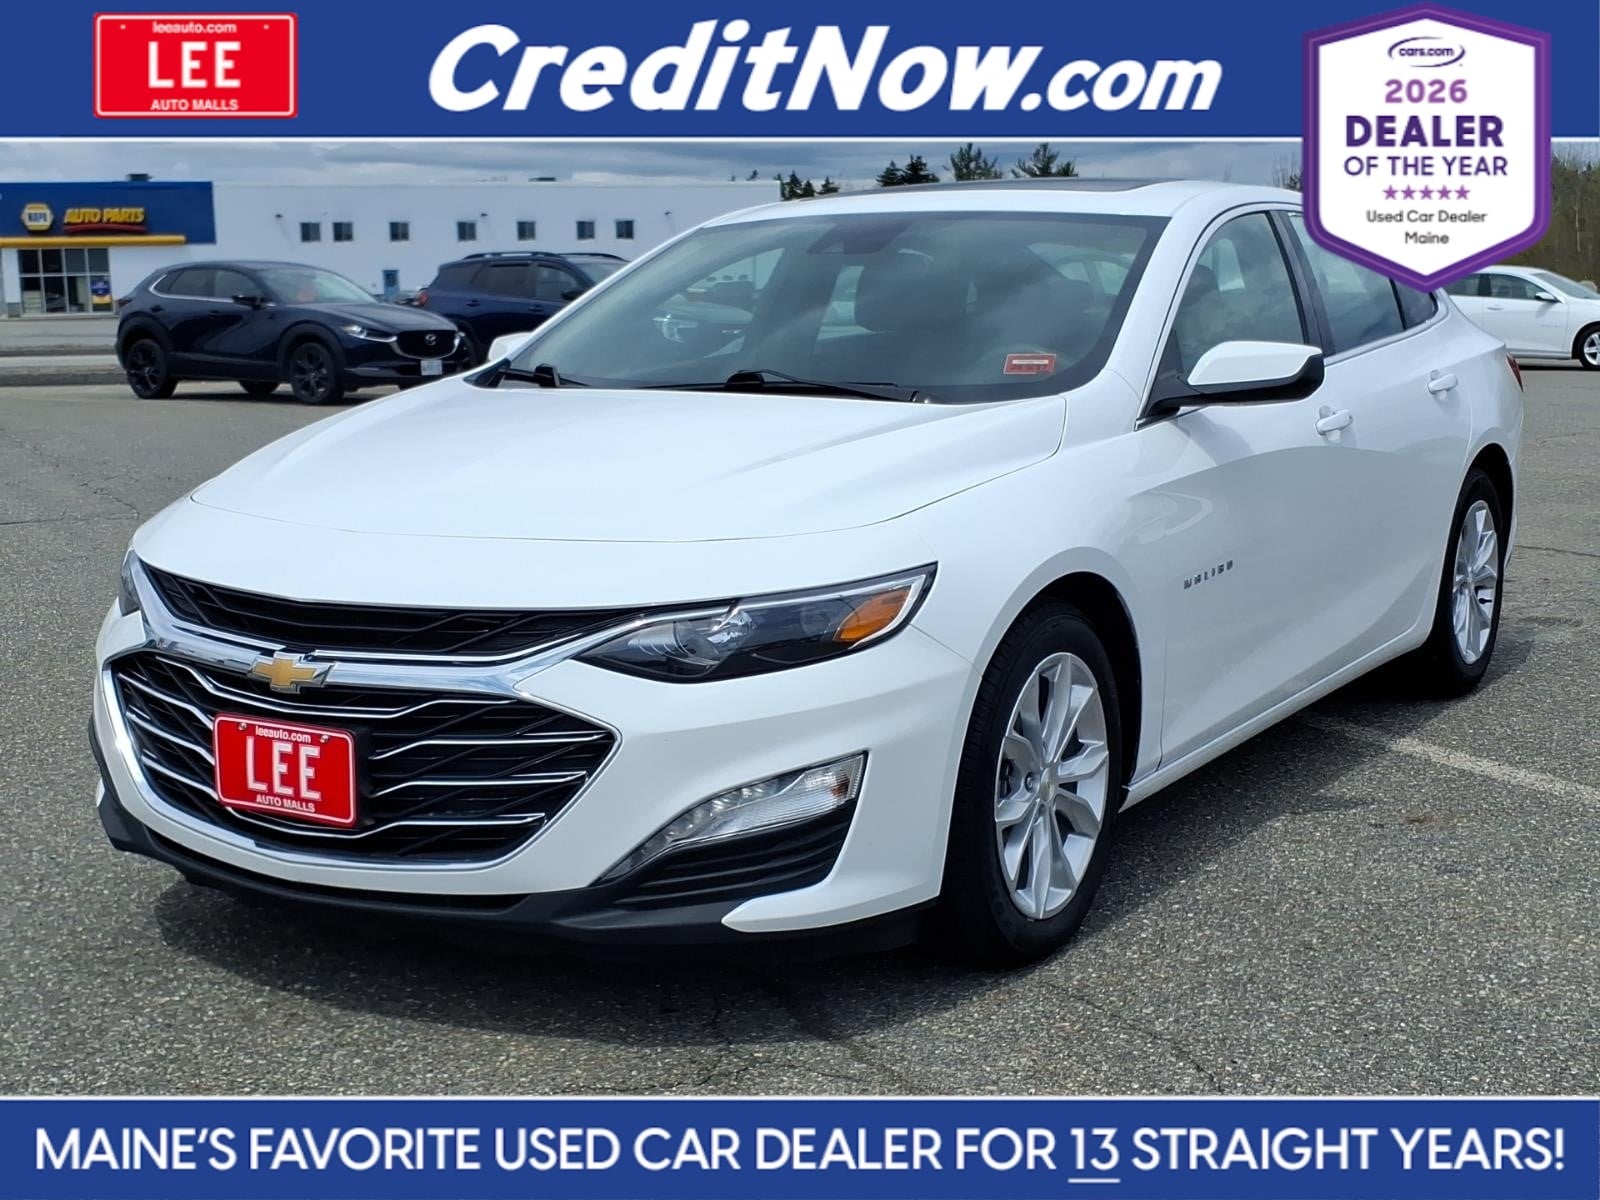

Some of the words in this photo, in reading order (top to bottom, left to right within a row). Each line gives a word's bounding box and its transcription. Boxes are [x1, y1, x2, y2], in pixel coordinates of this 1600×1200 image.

[63, 207, 102, 224] AUTO
[102, 207, 146, 224] PARTS
[1183, 559, 1234, 590] MALIBU
[255, 725, 312, 744] leeauto.com
[246, 736, 322, 801] LEE
[255, 794, 283, 807] AUTO
[283, 798, 316, 813] MALLS
